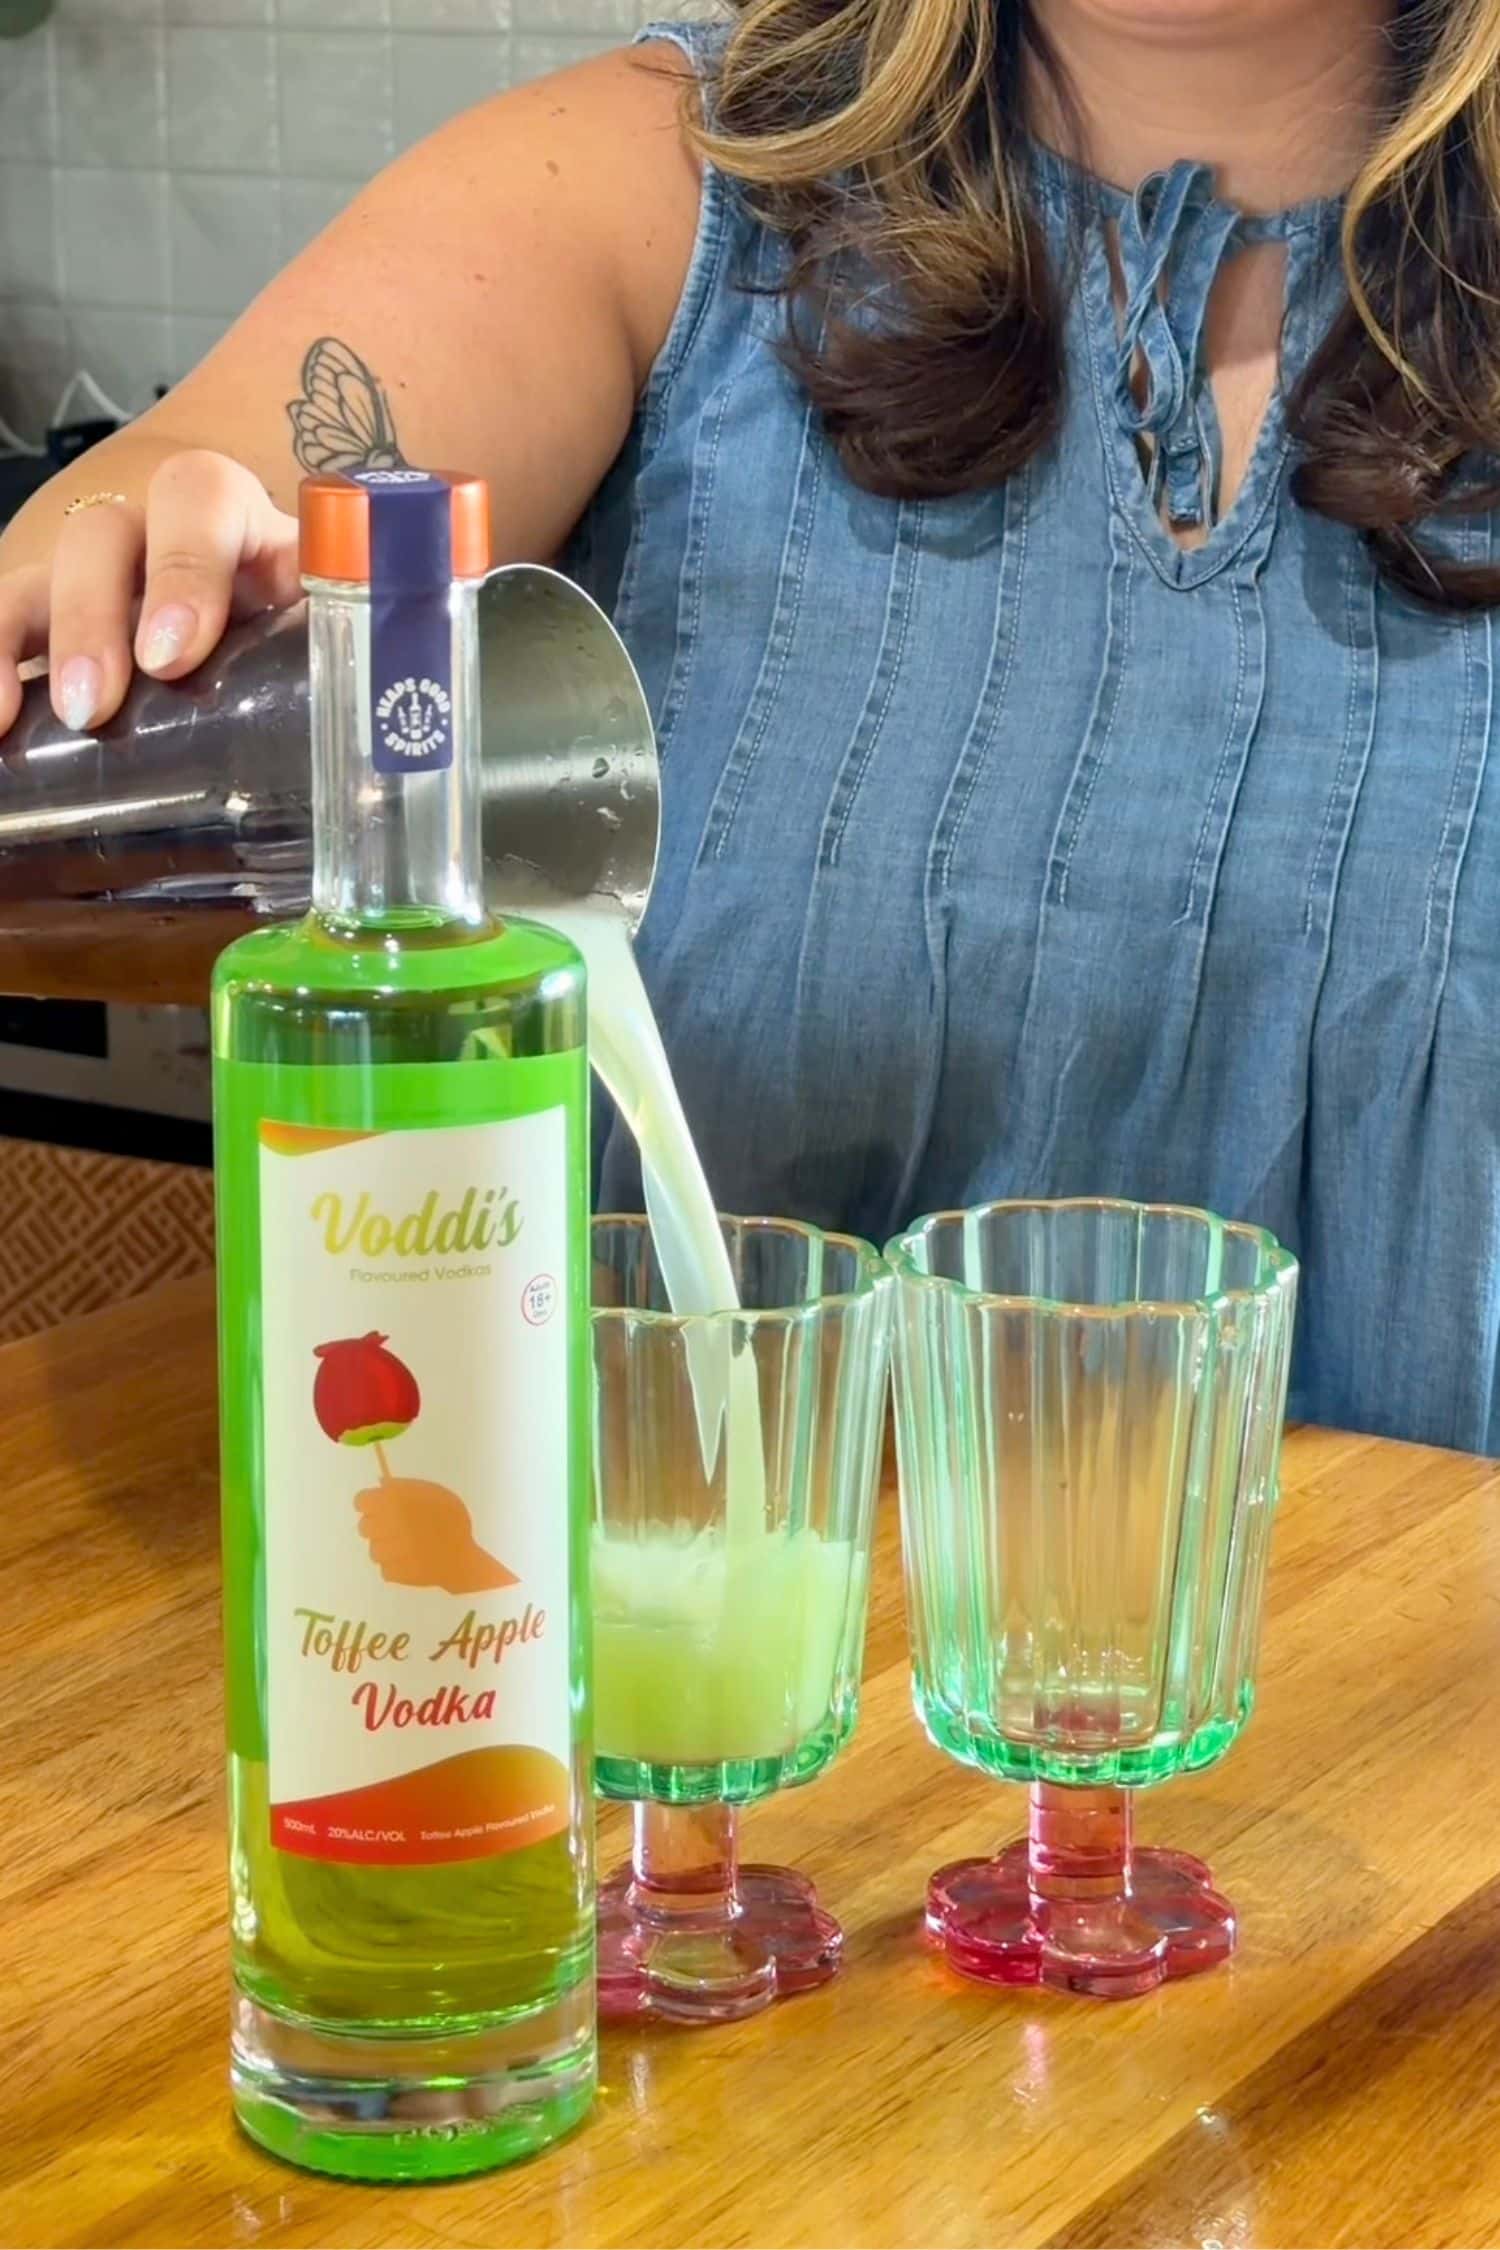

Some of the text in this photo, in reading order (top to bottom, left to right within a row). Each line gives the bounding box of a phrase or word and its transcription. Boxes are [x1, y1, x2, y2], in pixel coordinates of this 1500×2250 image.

[376, 677, 451, 718] HEAPS GOOD
[384, 729, 446, 757] SPIRITS
[309, 1186, 526, 1258] Voddi's
[349, 1263, 492, 1283] Flavoured Vodkas
[293, 1602, 546, 1673] Toffee Apple
[351, 1682, 497, 1732] Vodka
